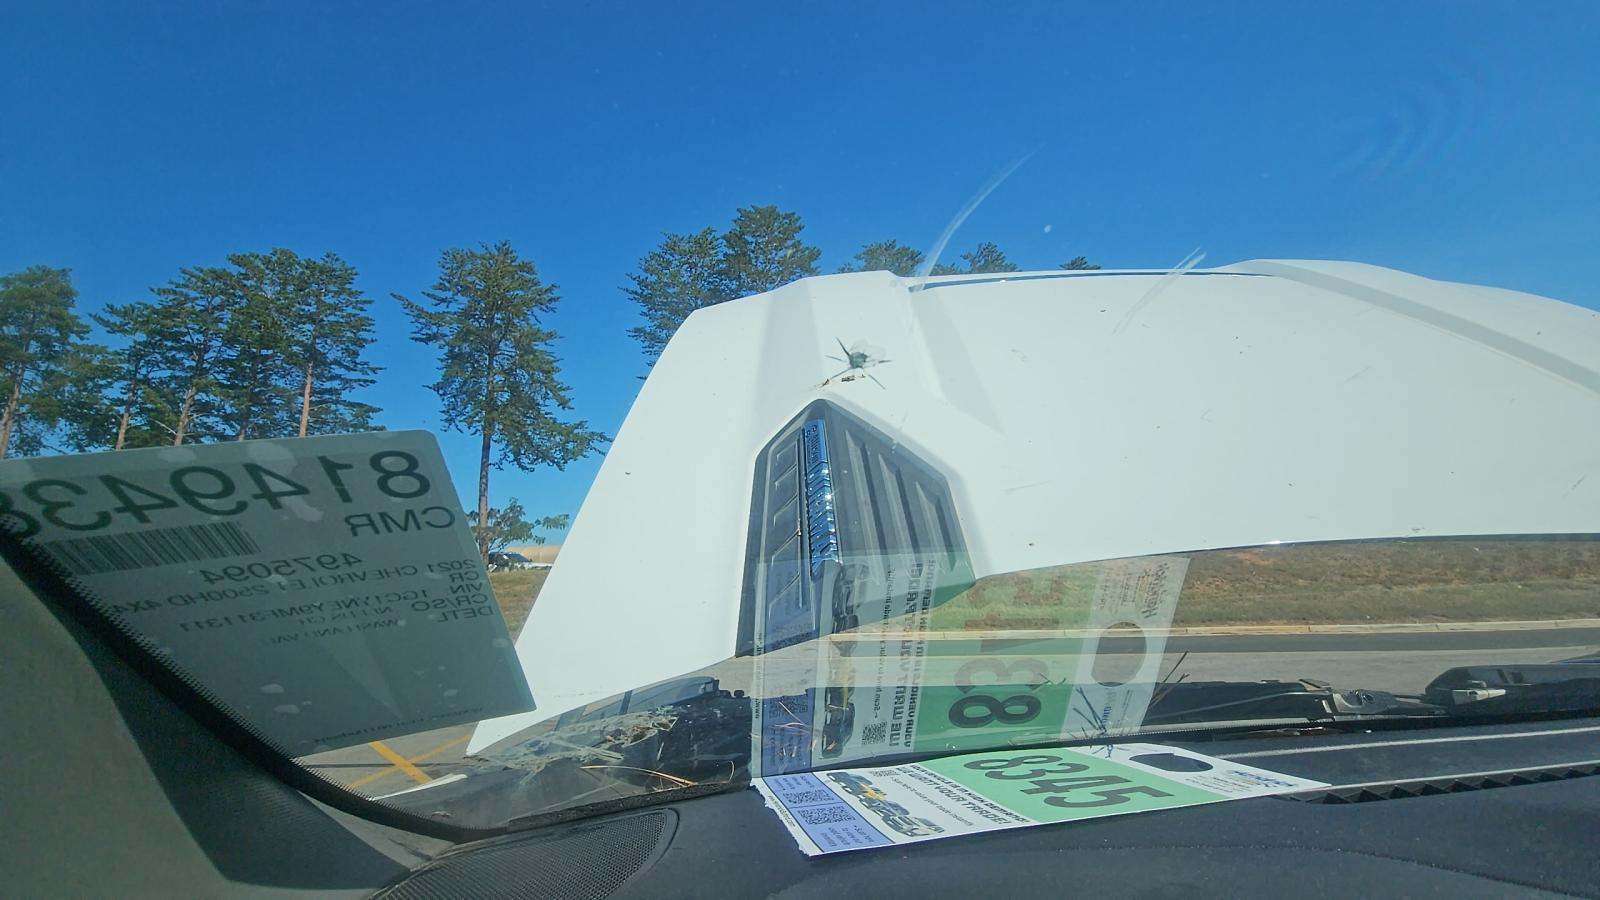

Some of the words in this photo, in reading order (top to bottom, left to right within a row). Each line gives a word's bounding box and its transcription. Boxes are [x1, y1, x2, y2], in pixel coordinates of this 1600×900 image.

[932, 785, 966, 802] YOUR
[960, 801, 1012, 824] TRADE!
[964, 755, 1175, 808] 8345
